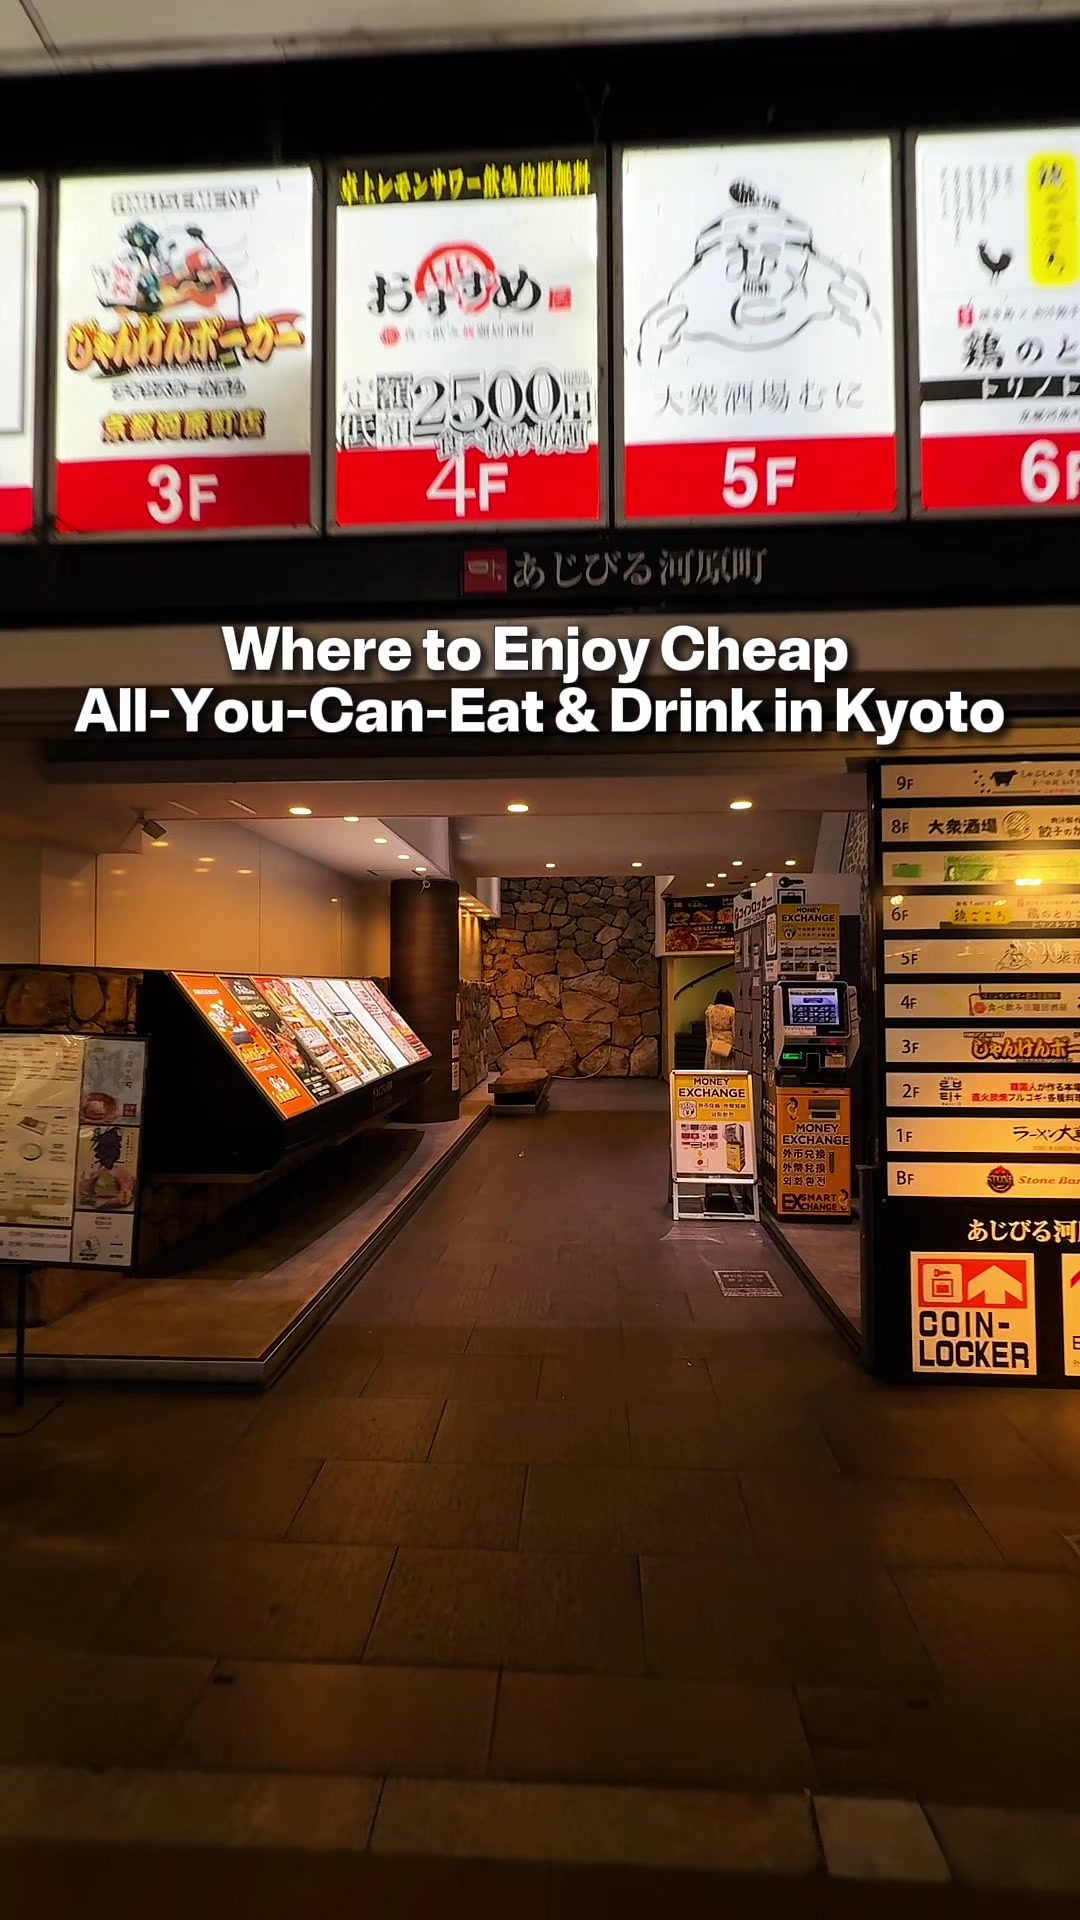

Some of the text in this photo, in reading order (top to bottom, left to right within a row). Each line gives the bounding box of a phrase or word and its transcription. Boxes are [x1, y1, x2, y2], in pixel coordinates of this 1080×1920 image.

[721, 446, 797, 508] 5F
[146, 463, 219, 525] 3F
[426, 456, 509, 517] 4F
[513, 547, 768, 590] あじびる河原町
[896, 775, 914, 791] 9F
[891, 818, 909, 834] 8F
[928, 818, 997, 835] 大衆酒場
[781, 914, 836, 922] EXCHANGE
[891, 907, 909, 921] 6F
[900, 953, 918, 965] 5F
[900, 995, 917, 1010] 4F
[901, 1039, 919, 1054] 3F
[693, 1078, 730, 1086] MONEY
[678, 1088, 746, 1098] EXCHANGE
[902, 1084, 920, 1099] 2F
[796, 1123, 839, 1133] MONEY
[896, 1128, 913, 1143] 1F
[782, 1135, 850, 1146] EXCHANGE
[896, 1170, 915, 1186] BF
[967, 1219, 1080, 1243] あじびる河
[919, 1311, 1010, 1338] COIN-
[919, 1340, 1030, 1369] LOCKER
